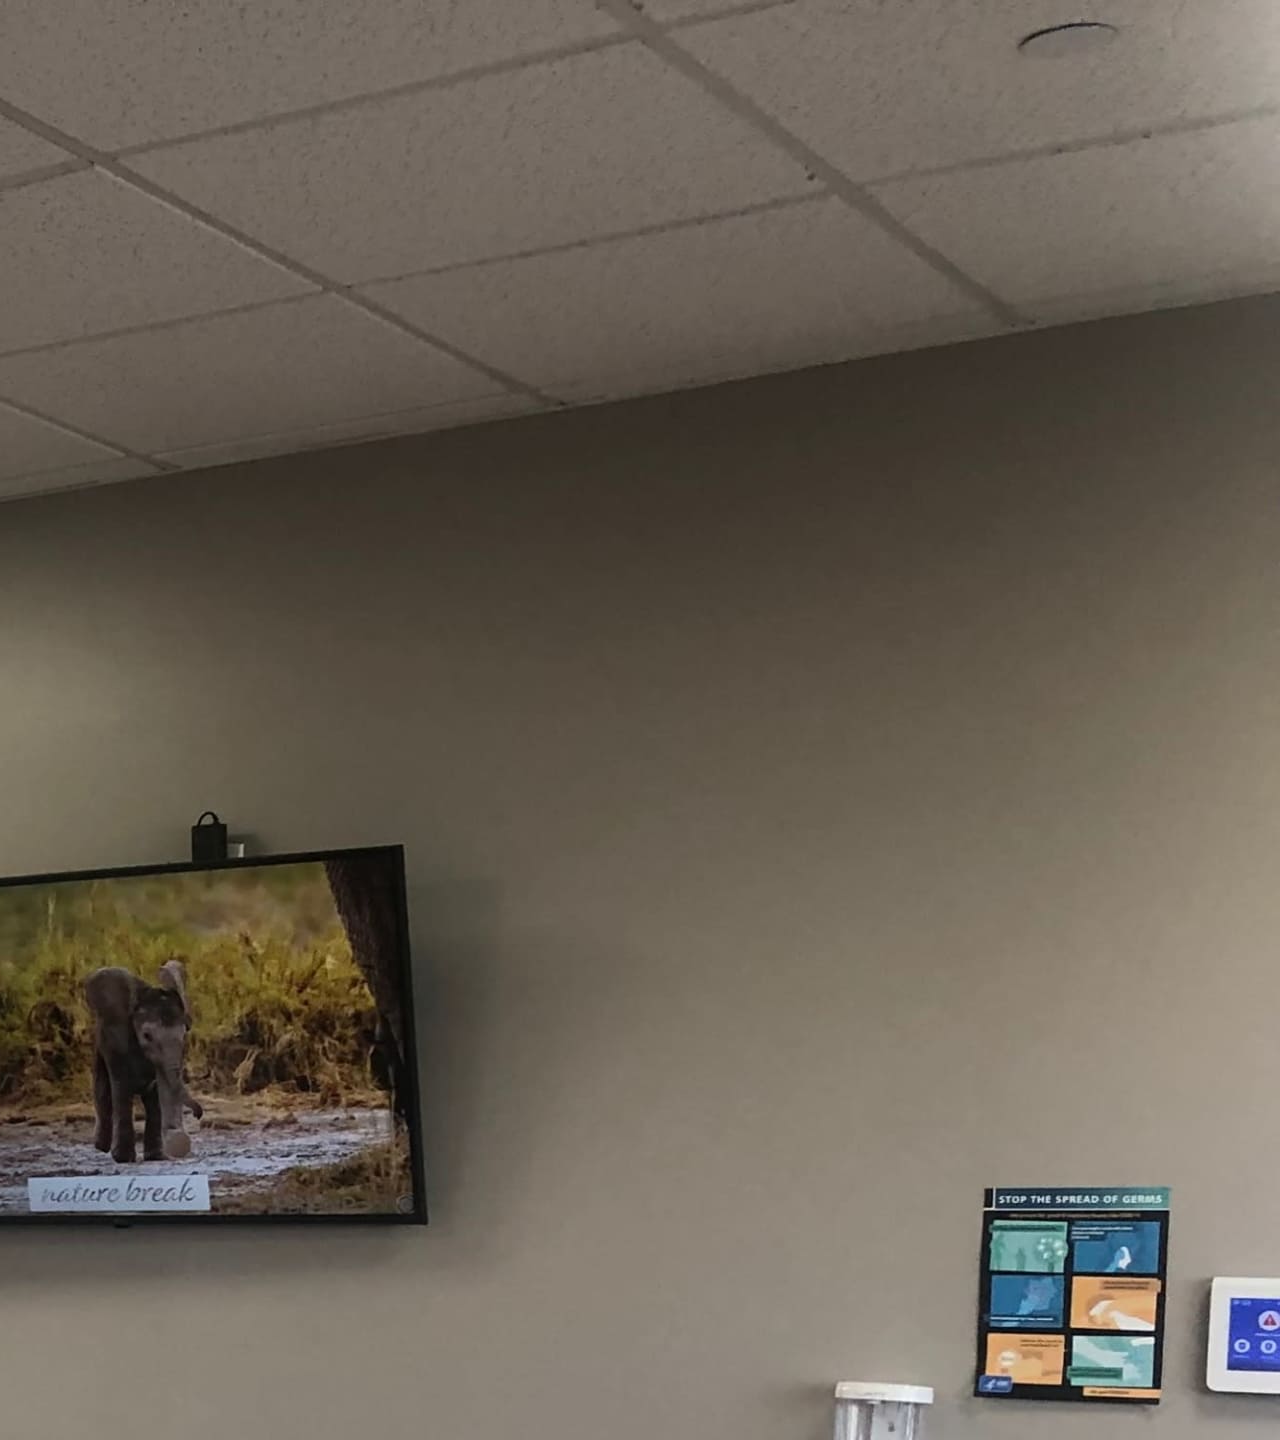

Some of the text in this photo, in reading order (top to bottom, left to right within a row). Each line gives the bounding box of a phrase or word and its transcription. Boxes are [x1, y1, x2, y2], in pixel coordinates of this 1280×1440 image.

[42, 1178, 196, 1203] nature break
[998, 1195, 1163, 1204] STOP THE SPREAD OF GERMS
